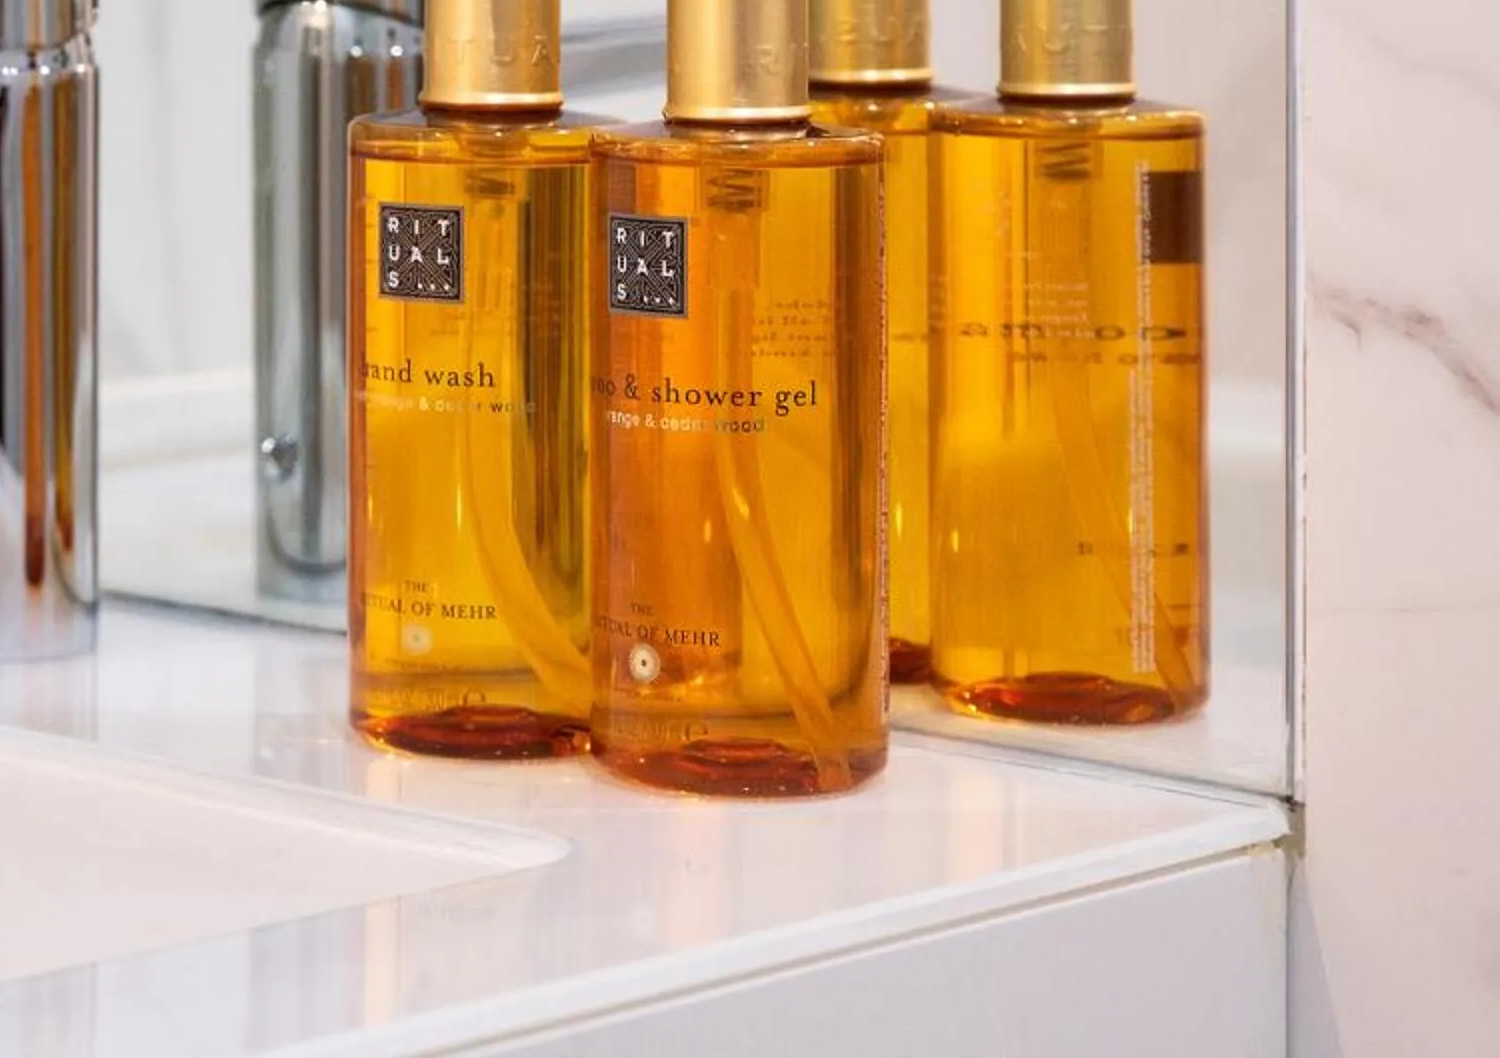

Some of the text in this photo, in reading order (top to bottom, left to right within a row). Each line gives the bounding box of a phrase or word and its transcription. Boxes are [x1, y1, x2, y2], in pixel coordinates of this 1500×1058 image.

[425, 362, 496, 388] wash
[592, 373, 817, 417] oo & shower gel
[644, 412, 658, 429] &
[403, 579, 430, 593] THE
[411, 601, 435, 618] OF
[440, 603, 498, 621] MEHR
[631, 602, 654, 617] THE
[637, 625, 660, 641] OF
[664, 628, 720, 648] MEHR
